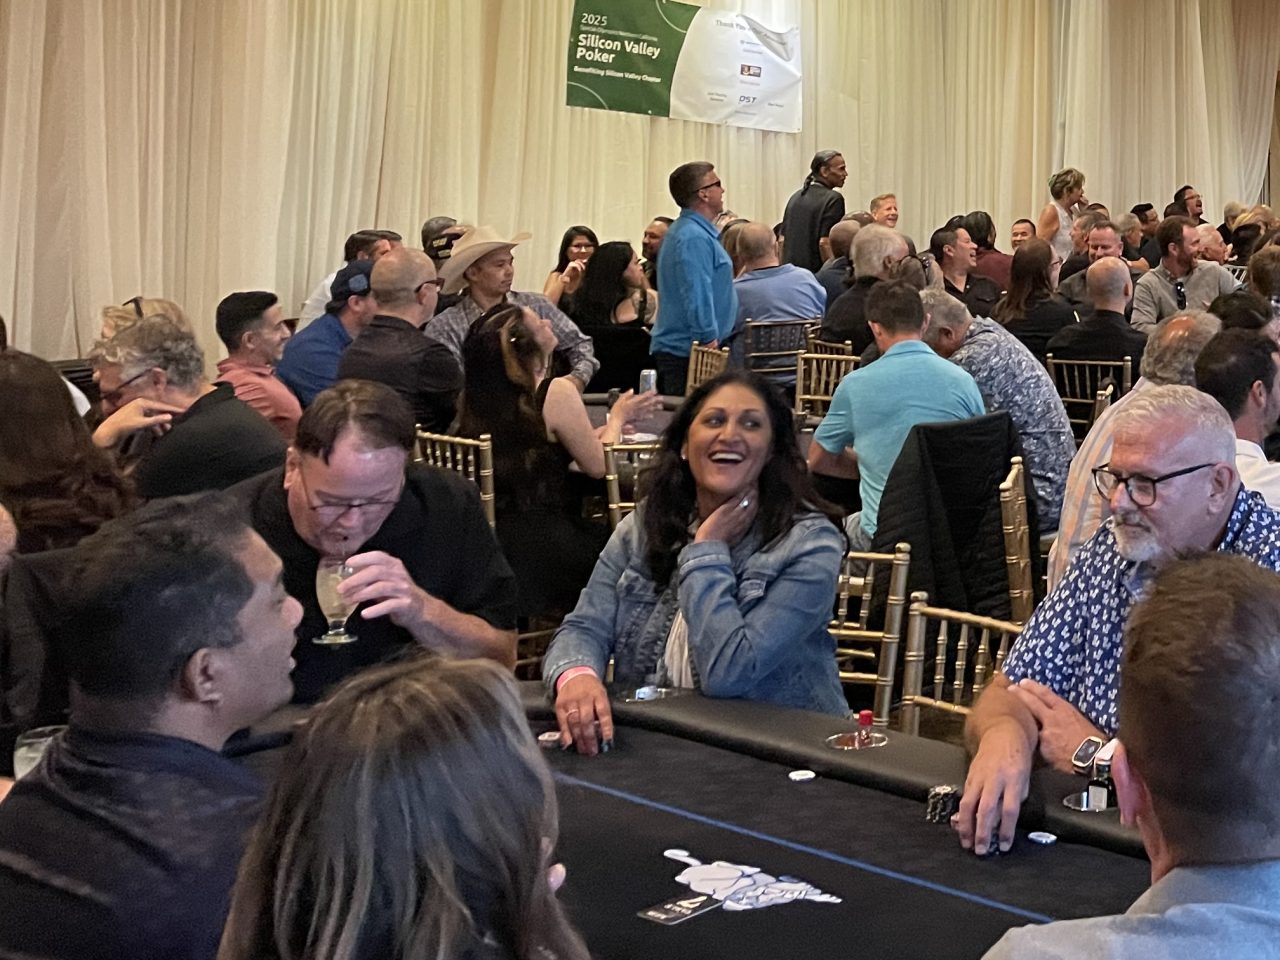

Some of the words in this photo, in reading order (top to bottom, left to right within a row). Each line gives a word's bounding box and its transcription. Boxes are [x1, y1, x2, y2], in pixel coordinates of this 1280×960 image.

[581, 13, 608, 26] 2025
[578, 34, 621, 51] Silicon
[624, 40, 661, 59] Valley
[576, 47, 616, 63] Poker
